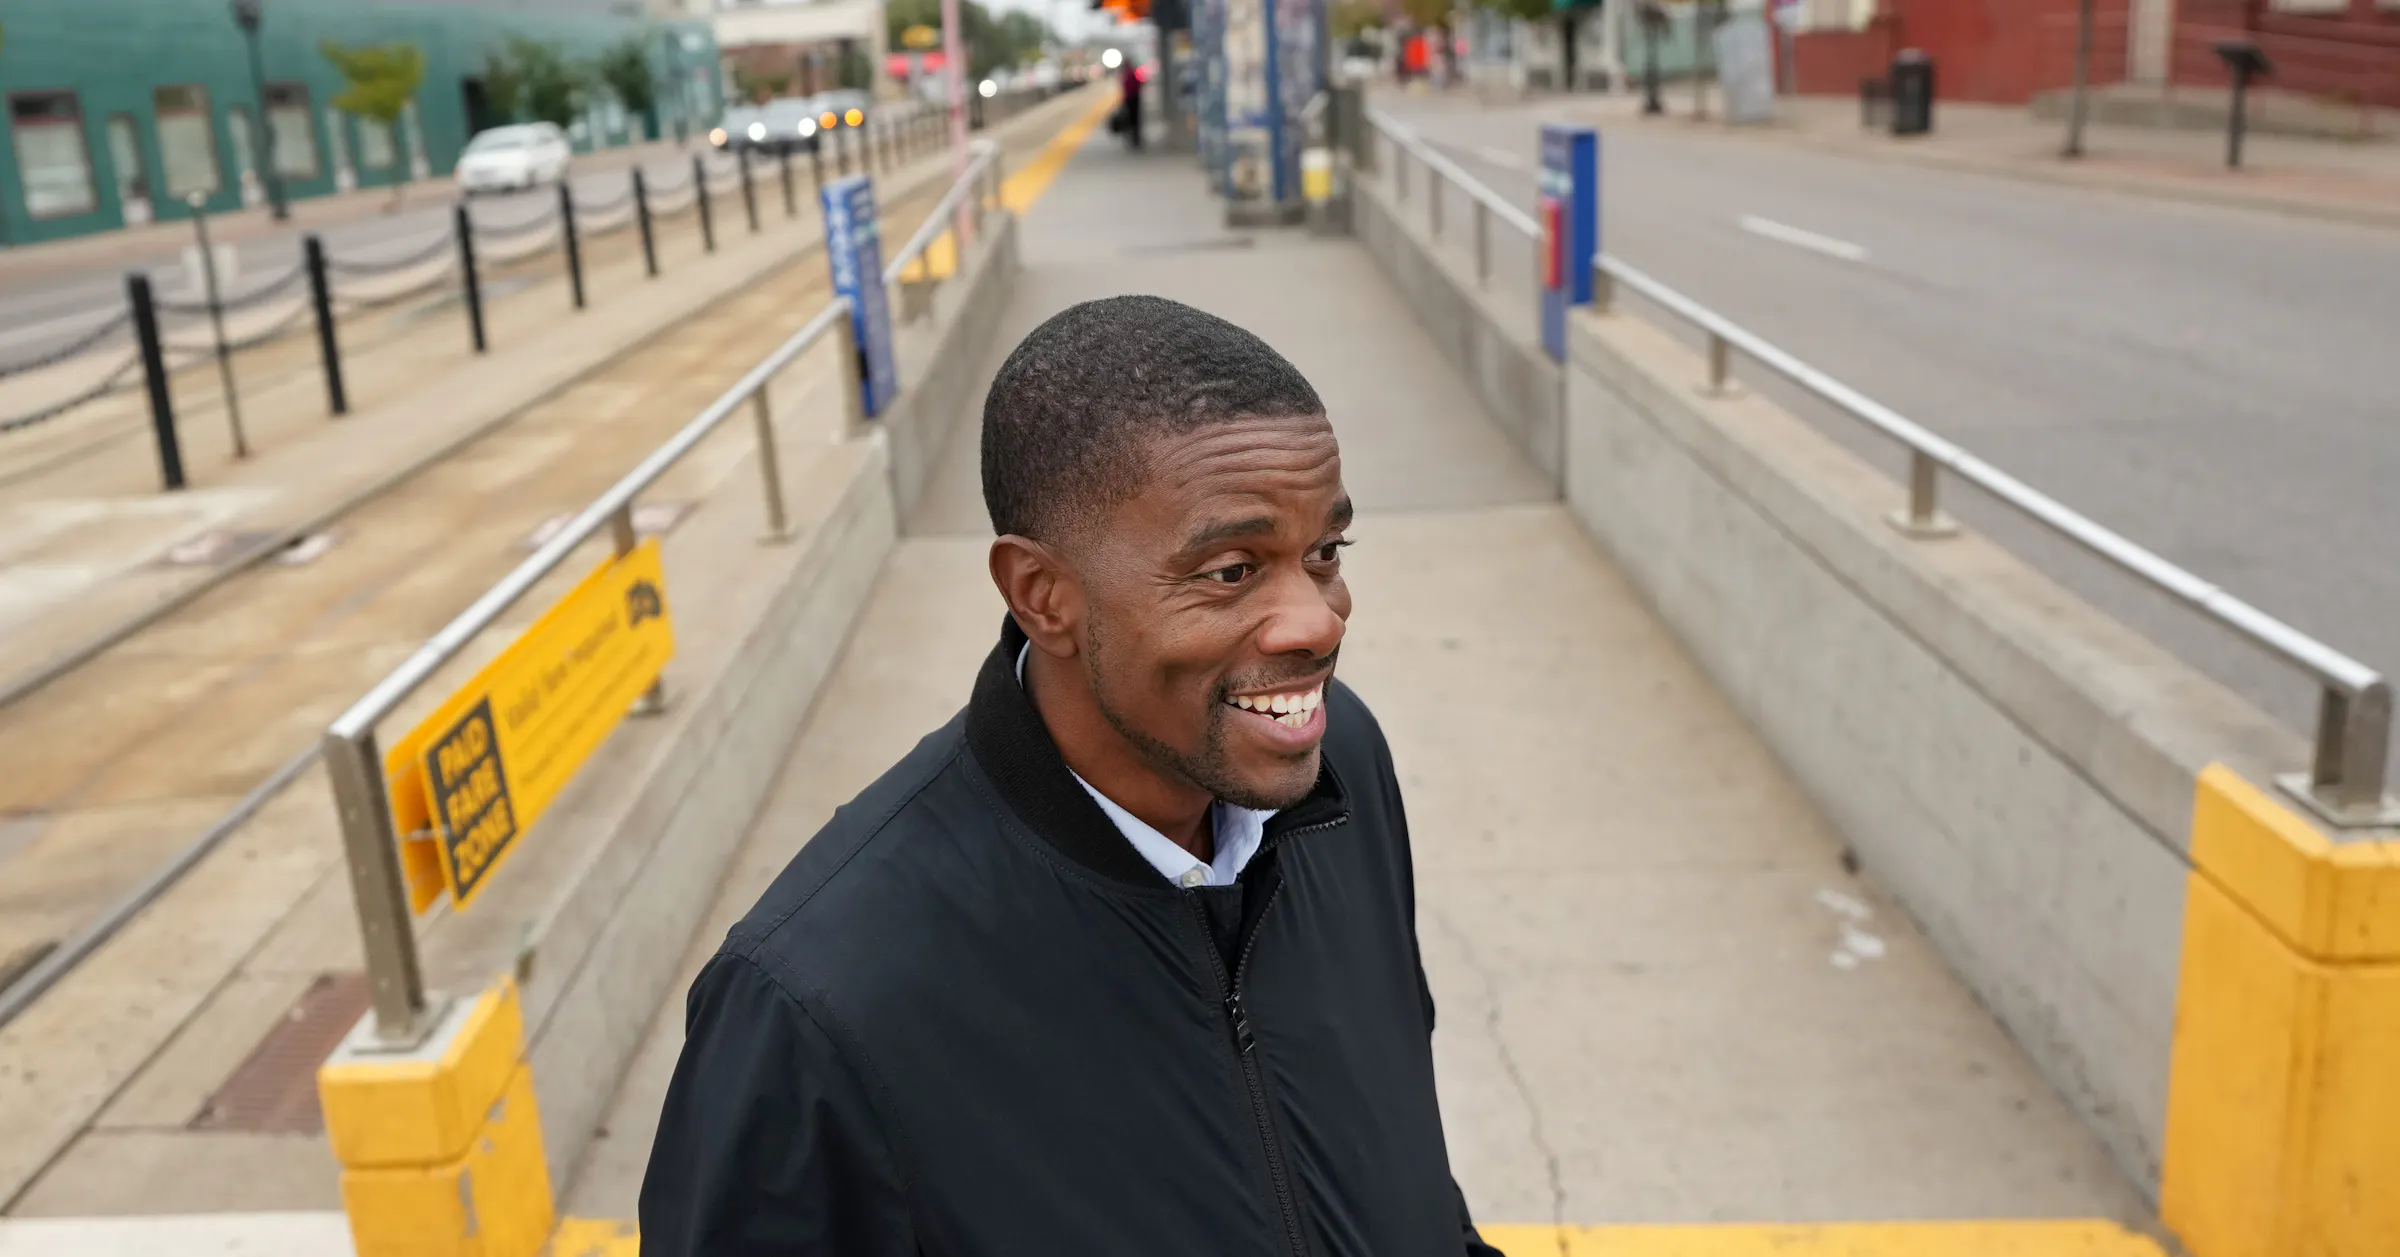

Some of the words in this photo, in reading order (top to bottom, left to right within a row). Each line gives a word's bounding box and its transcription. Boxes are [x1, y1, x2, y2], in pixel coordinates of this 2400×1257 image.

[438, 716, 489, 789] PAID
[446, 754, 499, 838] FARE
[453, 796, 511, 883] ZONE
